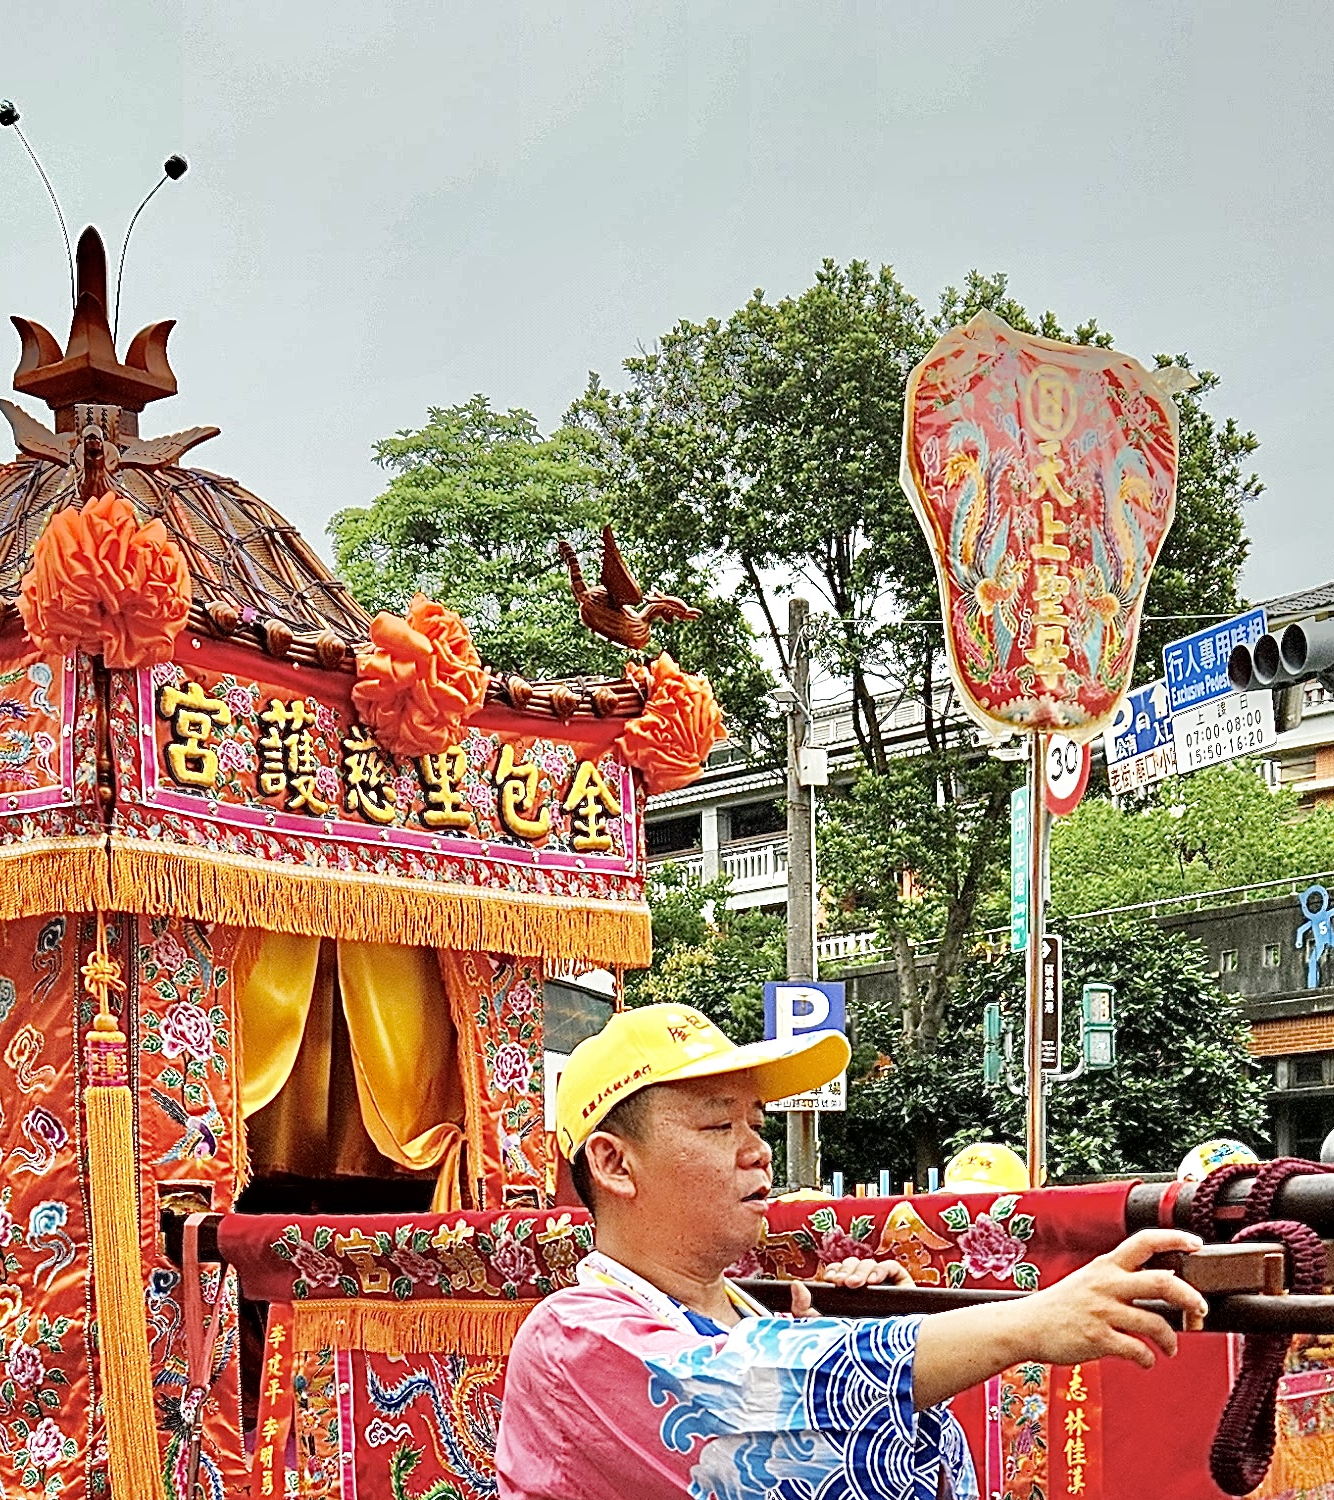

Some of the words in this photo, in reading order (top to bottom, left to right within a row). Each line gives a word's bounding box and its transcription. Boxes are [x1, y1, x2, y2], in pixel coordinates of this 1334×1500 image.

[1026, 440, 1076, 689] 天上聖母
[1171, 681, 1206, 707] Exclusive
[1050, 739, 1079, 782] 30
[1318, 921, 1328, 935] 5
[776, 986, 831, 1039] P
[259, 1415, 280, 1497] 李明勇
